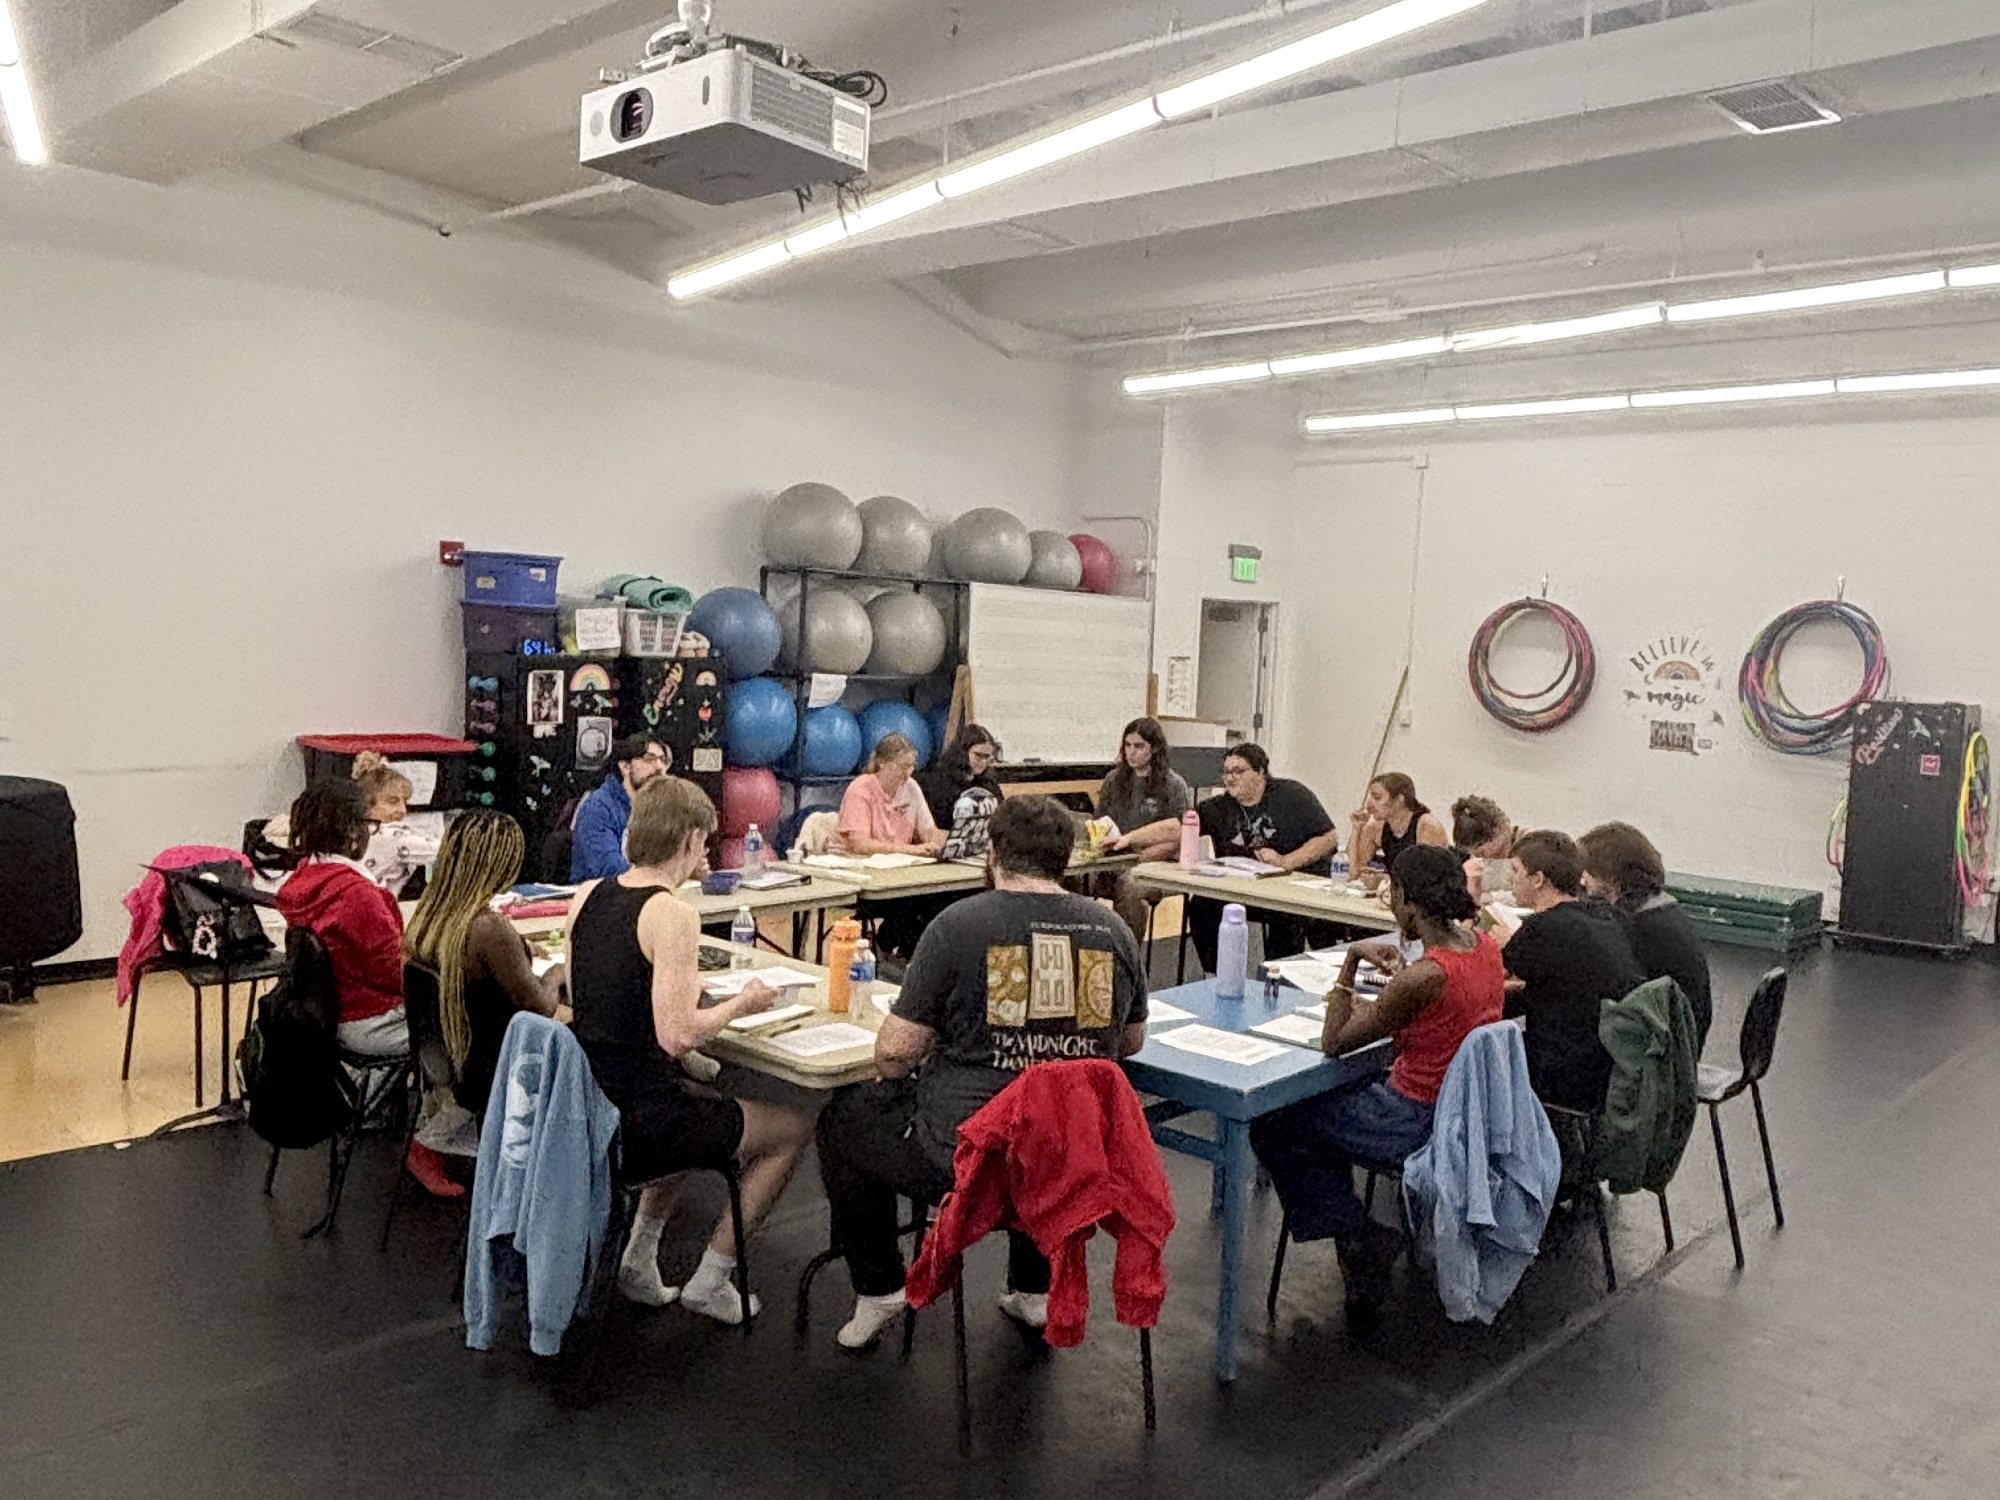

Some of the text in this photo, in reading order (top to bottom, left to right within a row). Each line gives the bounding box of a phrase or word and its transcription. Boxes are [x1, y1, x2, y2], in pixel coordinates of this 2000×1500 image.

[1629, 636, 1699, 672] BELIEVE
[1647, 691, 1705, 711] magic
[1011, 1033, 1099, 1056] MIDNIGHT
